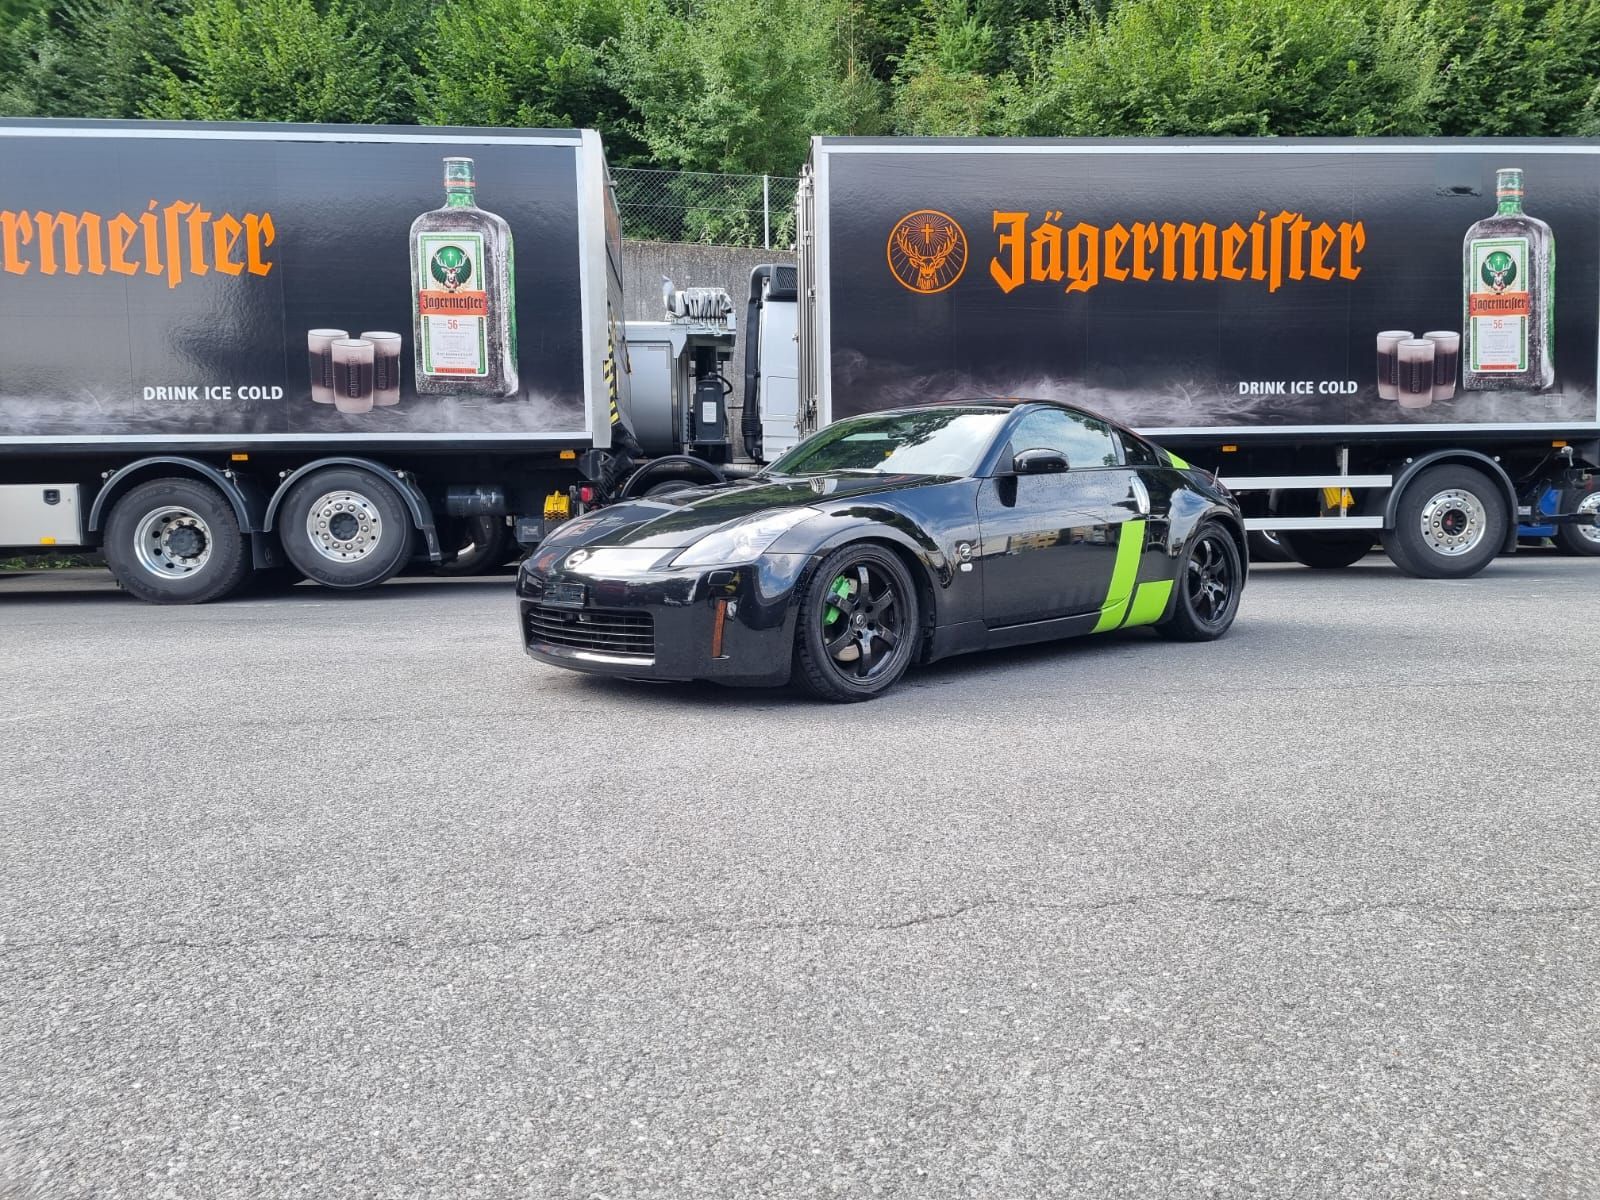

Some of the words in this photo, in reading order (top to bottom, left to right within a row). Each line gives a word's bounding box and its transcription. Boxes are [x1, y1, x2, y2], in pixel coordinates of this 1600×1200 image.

[990, 210, 1366, 294] Jägermeister
[447, 319, 458, 330] 56
[1493, 319, 1503, 329] 56
[143, 385, 199, 401] DRINK
[204, 385, 232, 400] ICE
[237, 385, 284, 400] COLD
[1239, 381, 1286, 395] DRINK
[1291, 381, 1314, 395] ICE
[1318, 380, 1358, 395] COLD
